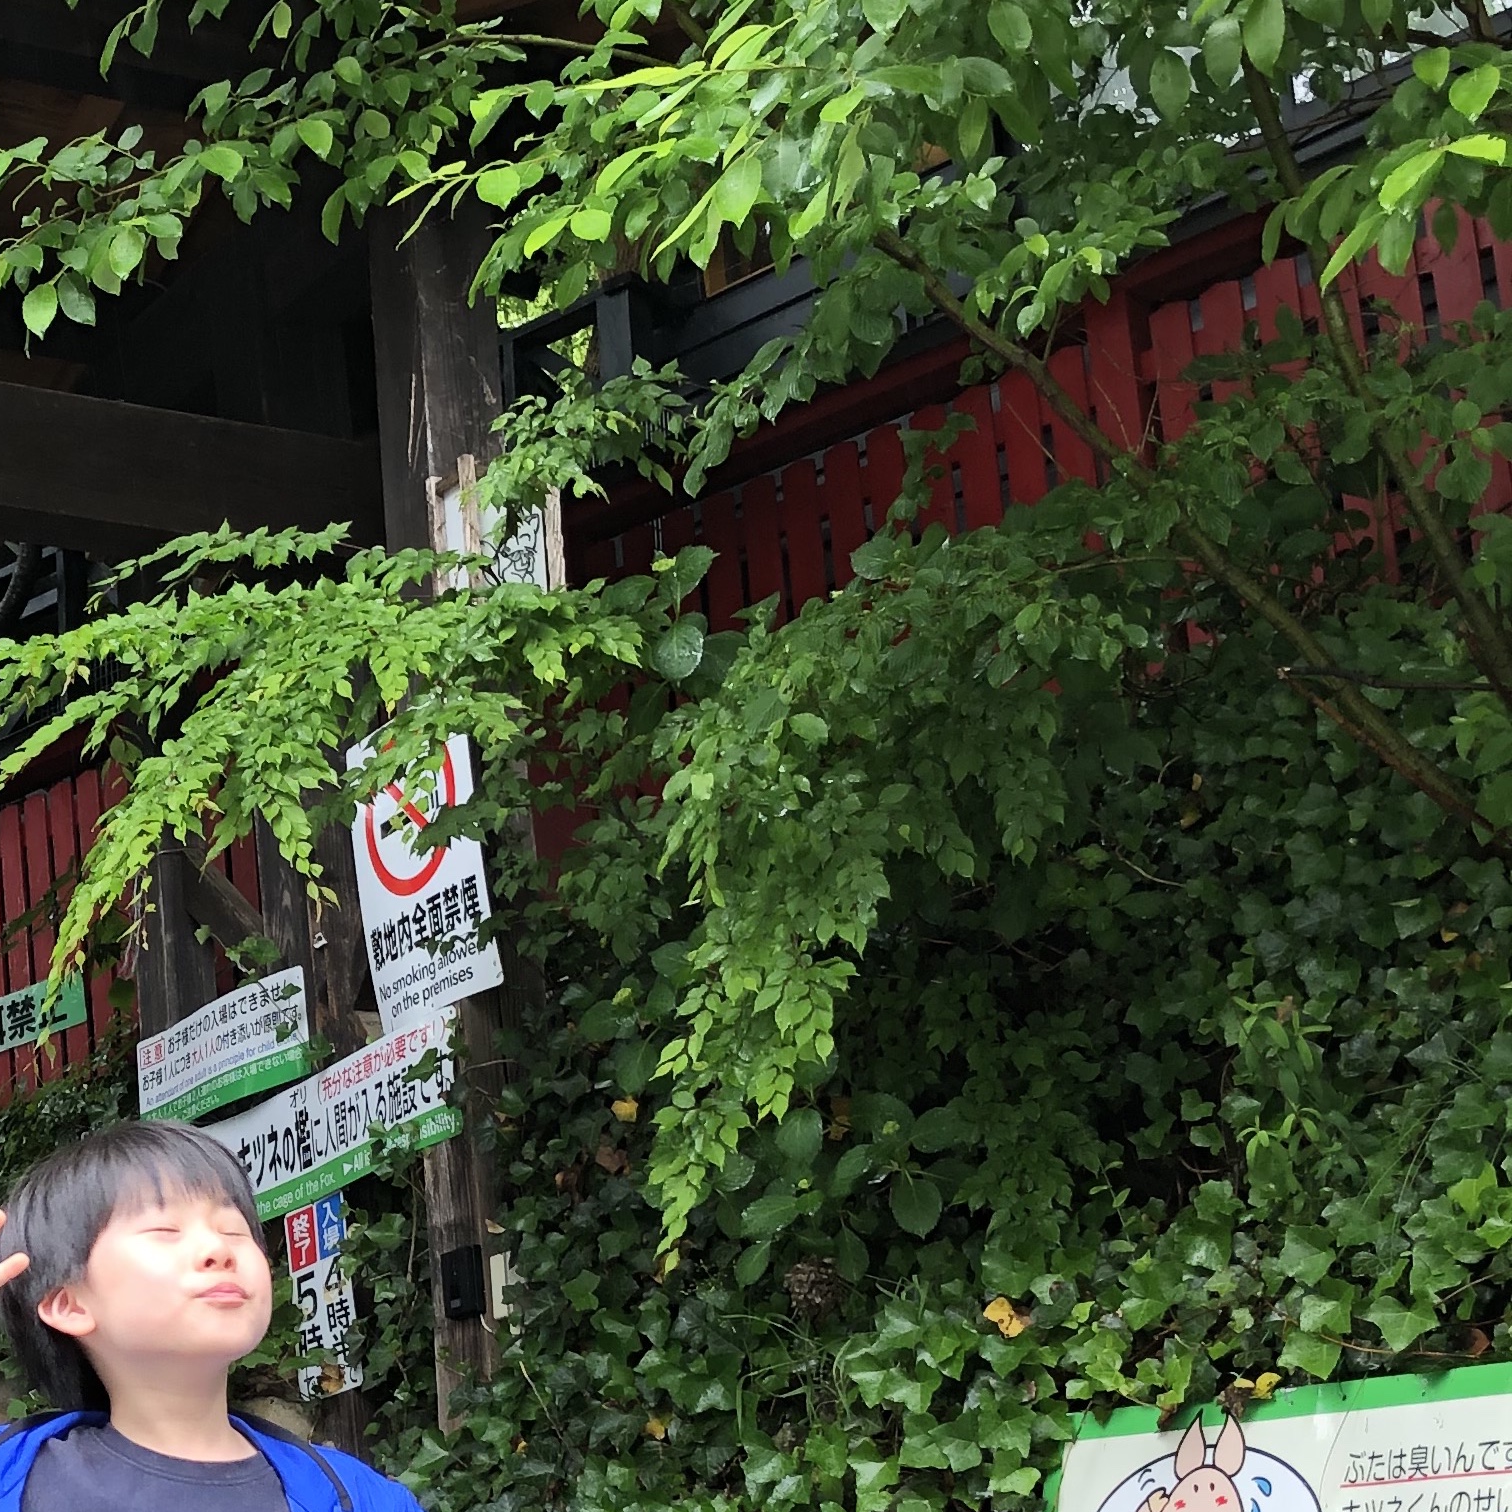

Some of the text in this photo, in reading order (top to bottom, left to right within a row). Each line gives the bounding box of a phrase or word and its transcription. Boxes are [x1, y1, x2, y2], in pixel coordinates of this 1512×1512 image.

[378, 940, 479, 1004] No smoking allowe
[391, 965, 474, 1018] on the premises
[142, 1042, 163, 1066] 注意
[245, 1046, 256, 1058] for
[257, 1040, 275, 1053] child
[289, 1084, 308, 1109] オリ
[353, 1152, 364, 1173] All
[272, 1192, 294, 1211] cage
[294, 1184, 304, 1201] of
[305, 1179, 319, 1196] the
[291, 1212, 311, 1267] 終了
[321, 1200, 341, 1251] 入場
